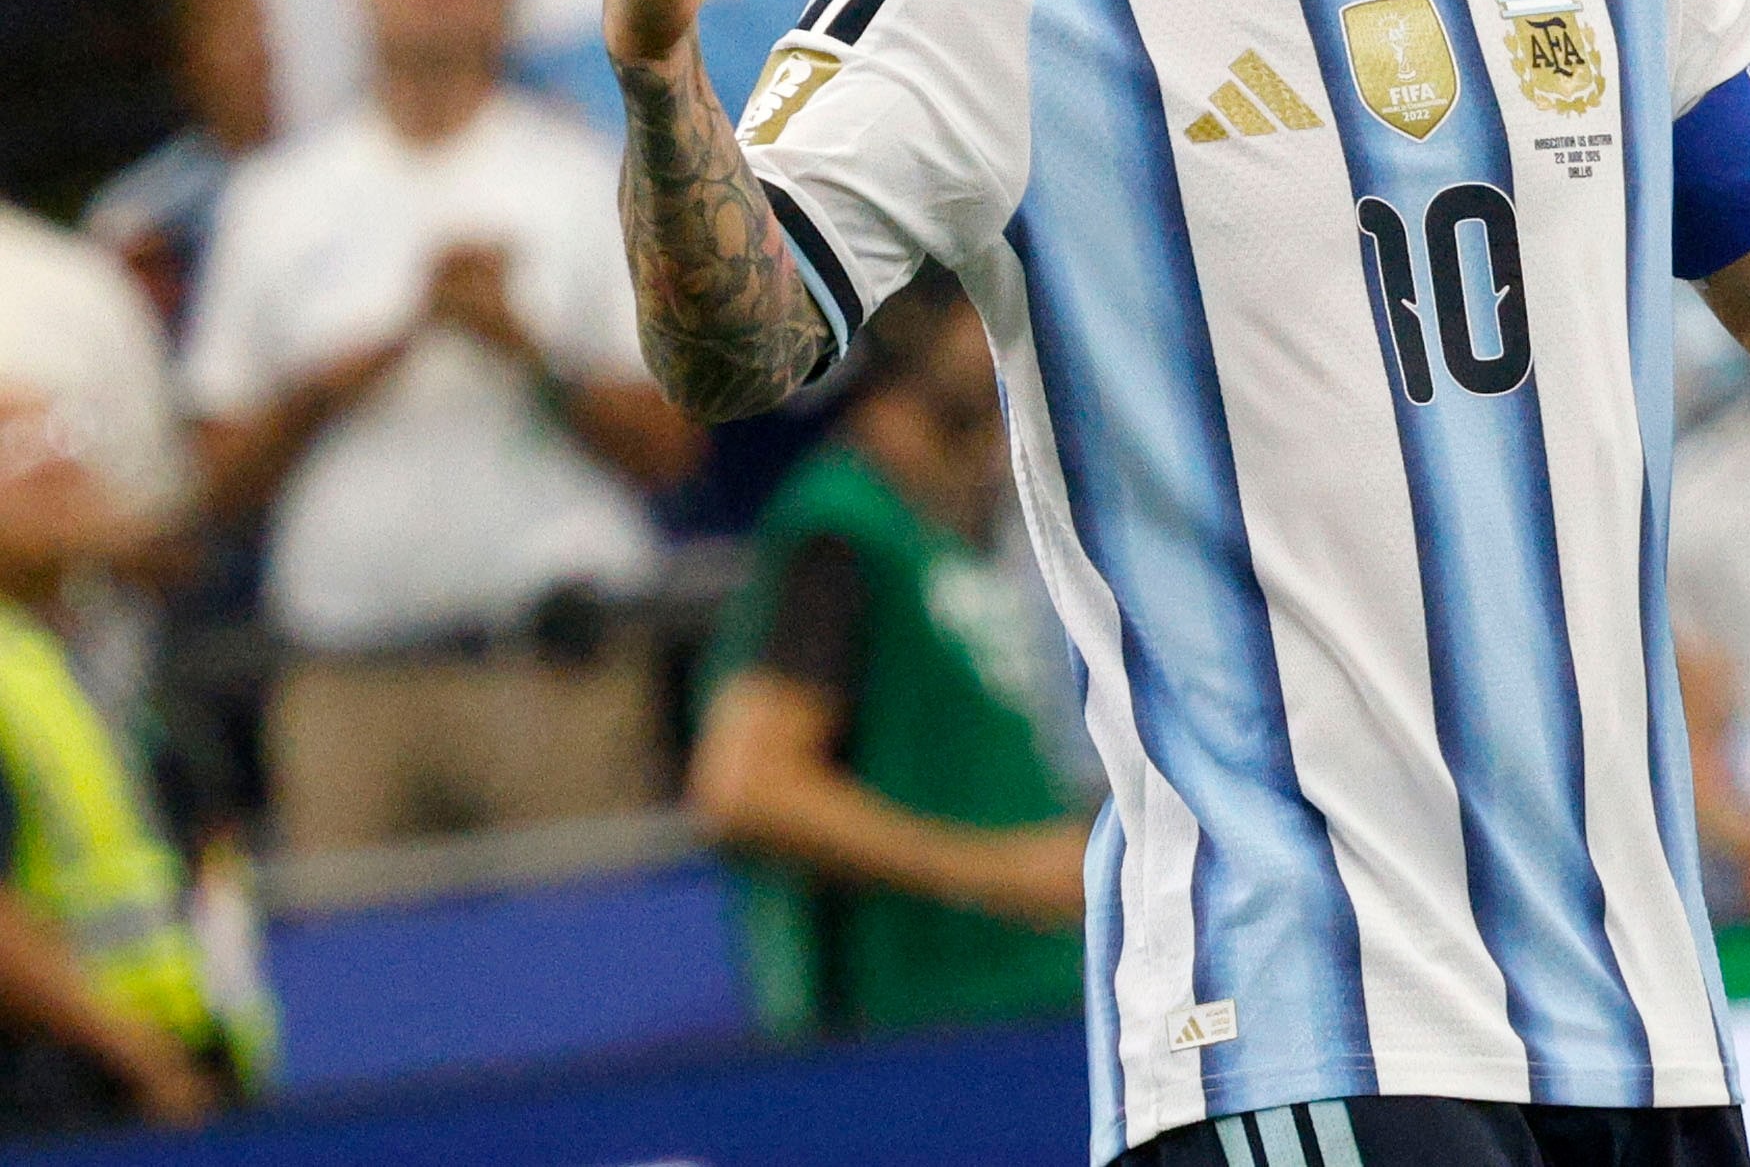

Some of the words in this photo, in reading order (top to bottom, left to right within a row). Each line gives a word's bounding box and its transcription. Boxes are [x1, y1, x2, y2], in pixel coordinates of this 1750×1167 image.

[1525, 17, 1585, 77] AFA
[1390, 83, 1436, 105] FIFA
[1402, 109, 1430, 121] 2022
[1555, 152, 1565, 164] 22
[1356, 182, 1533, 405] 10
